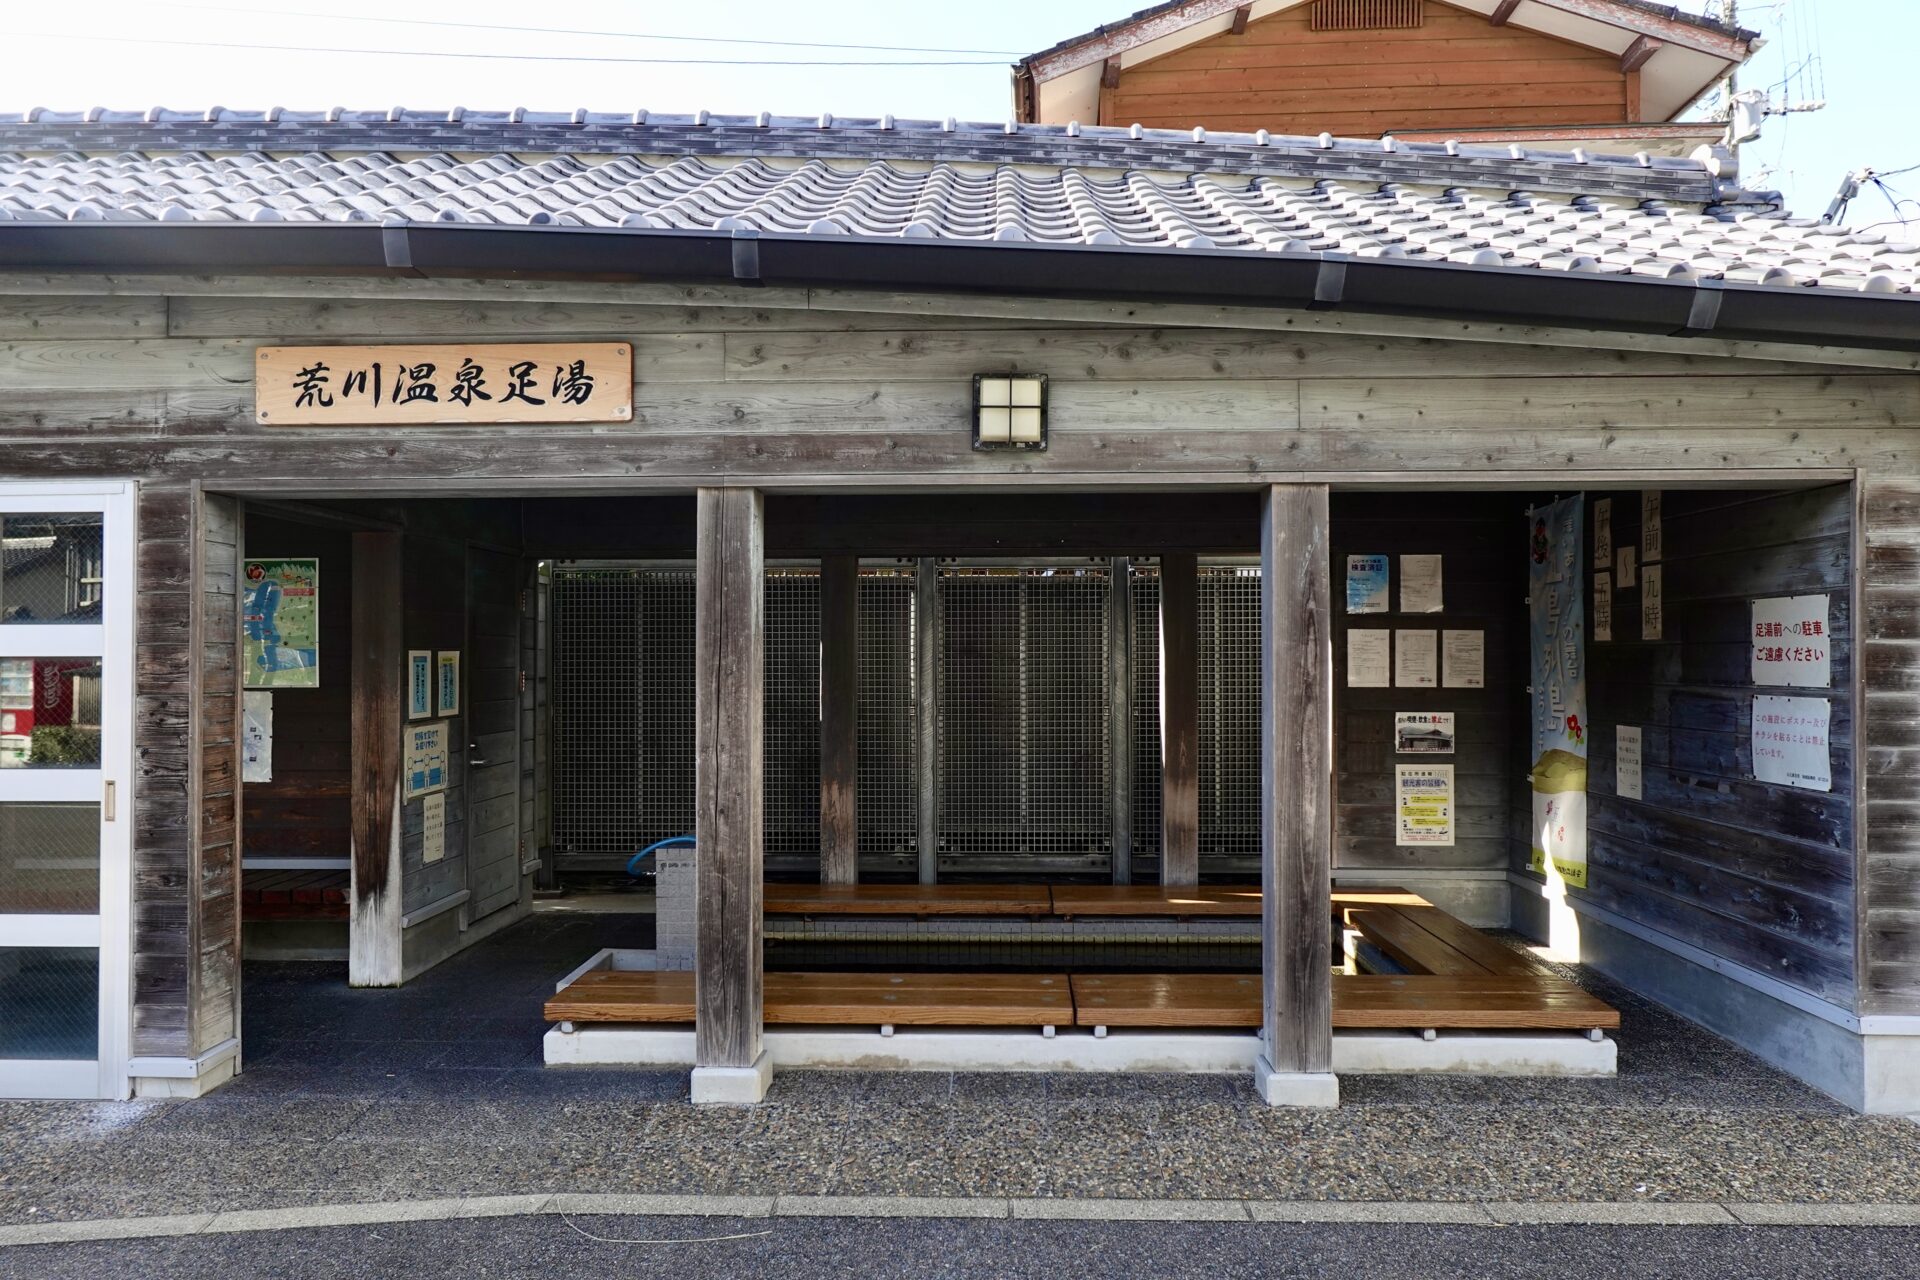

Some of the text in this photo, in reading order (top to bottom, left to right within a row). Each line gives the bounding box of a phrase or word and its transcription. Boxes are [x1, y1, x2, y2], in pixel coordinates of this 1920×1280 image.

[291, 357, 596, 409] 荒川温泉足湯
[1595, 507, 1610, 632] 午後 五時
[1644, 495, 1661, 631] 午前 九時
[1755, 620, 1824, 638] 足湯前への駐車
[1755, 646, 1824, 662] ご遠慮ください
[1755, 714, 1827, 728] この施設にポスター及び
[1754, 731, 1826, 746] チラシを貼ることは禁止
[1754, 746, 1785, 759] しています。
[1402, 778, 1447, 788] 観光客の皆様へ
